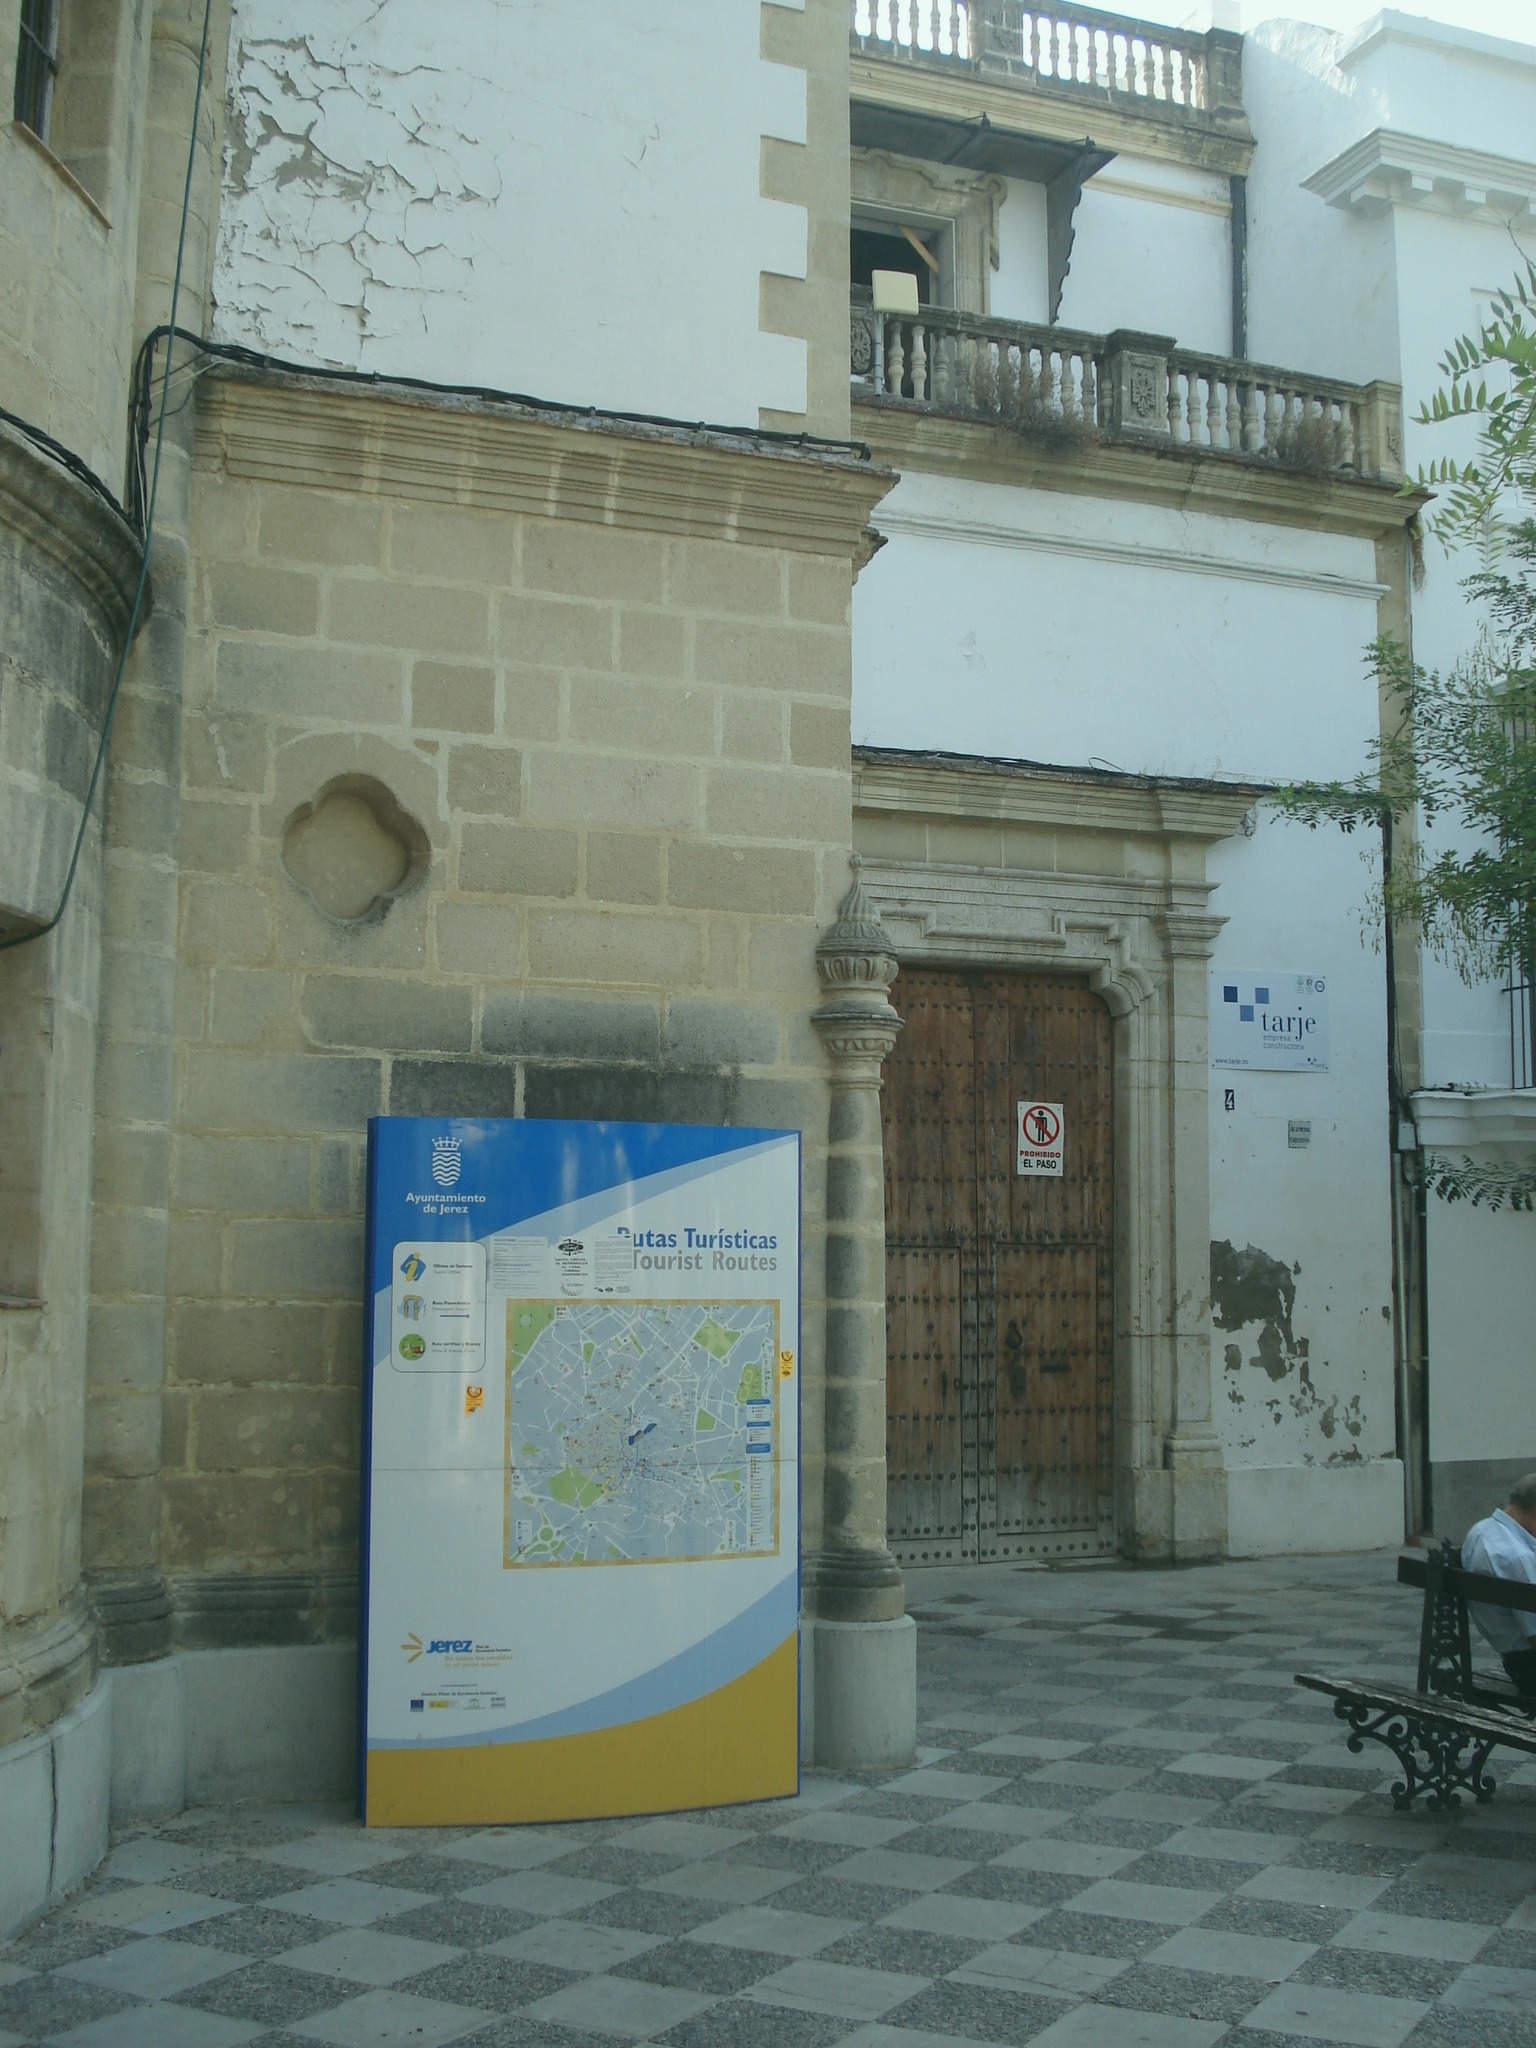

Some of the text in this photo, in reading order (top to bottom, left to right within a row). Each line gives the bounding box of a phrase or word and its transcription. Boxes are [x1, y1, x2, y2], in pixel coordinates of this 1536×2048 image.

[1261, 1006, 1317, 1041] tarje
[1262, 1034, 1291, 1042] empresa
[1262, 1042, 1305, 1051] constructora
[1225, 1091, 1234, 1109] 4
[1019, 1150, 1061, 1159] PROHIBIDO
[1023, 1159, 1057, 1169] EL PASO
[405, 1192, 486, 1204] Ayuntamiento
[422, 1204, 469, 1215] de Jerez
[684, 1227, 777, 1249] Turísticas
[712, 1250, 777, 1271] Routes
